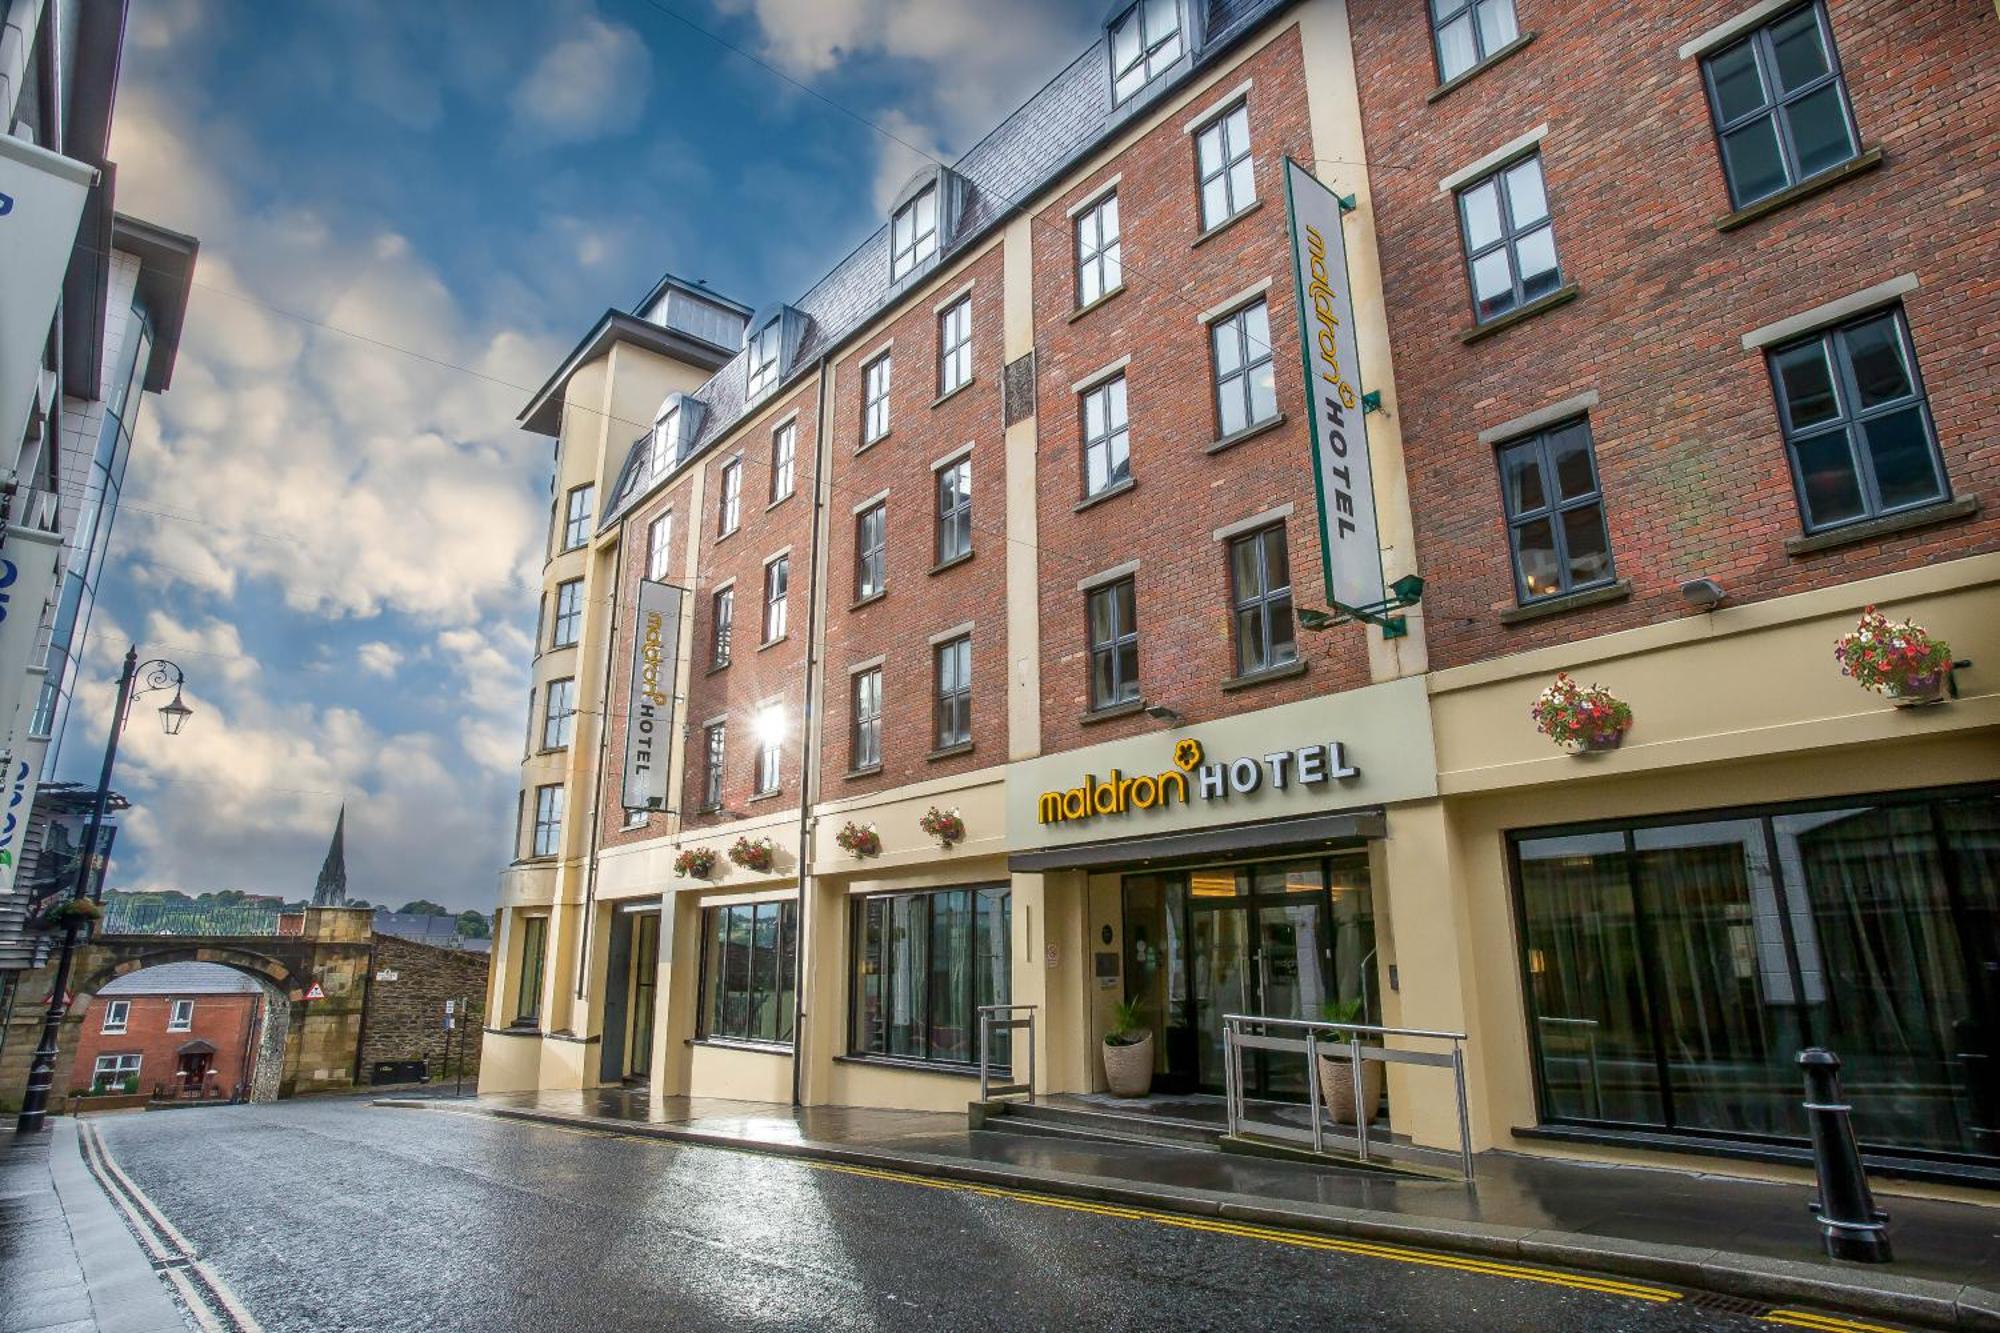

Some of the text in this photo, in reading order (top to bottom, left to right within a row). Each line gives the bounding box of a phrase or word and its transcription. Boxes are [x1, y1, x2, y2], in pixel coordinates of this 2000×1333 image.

[1306, 224, 1356, 539] maldron HOTEL
[635, 611, 663, 775] maldron HOTEL
[1038, 741, 1361, 825] maldron HOTEL
